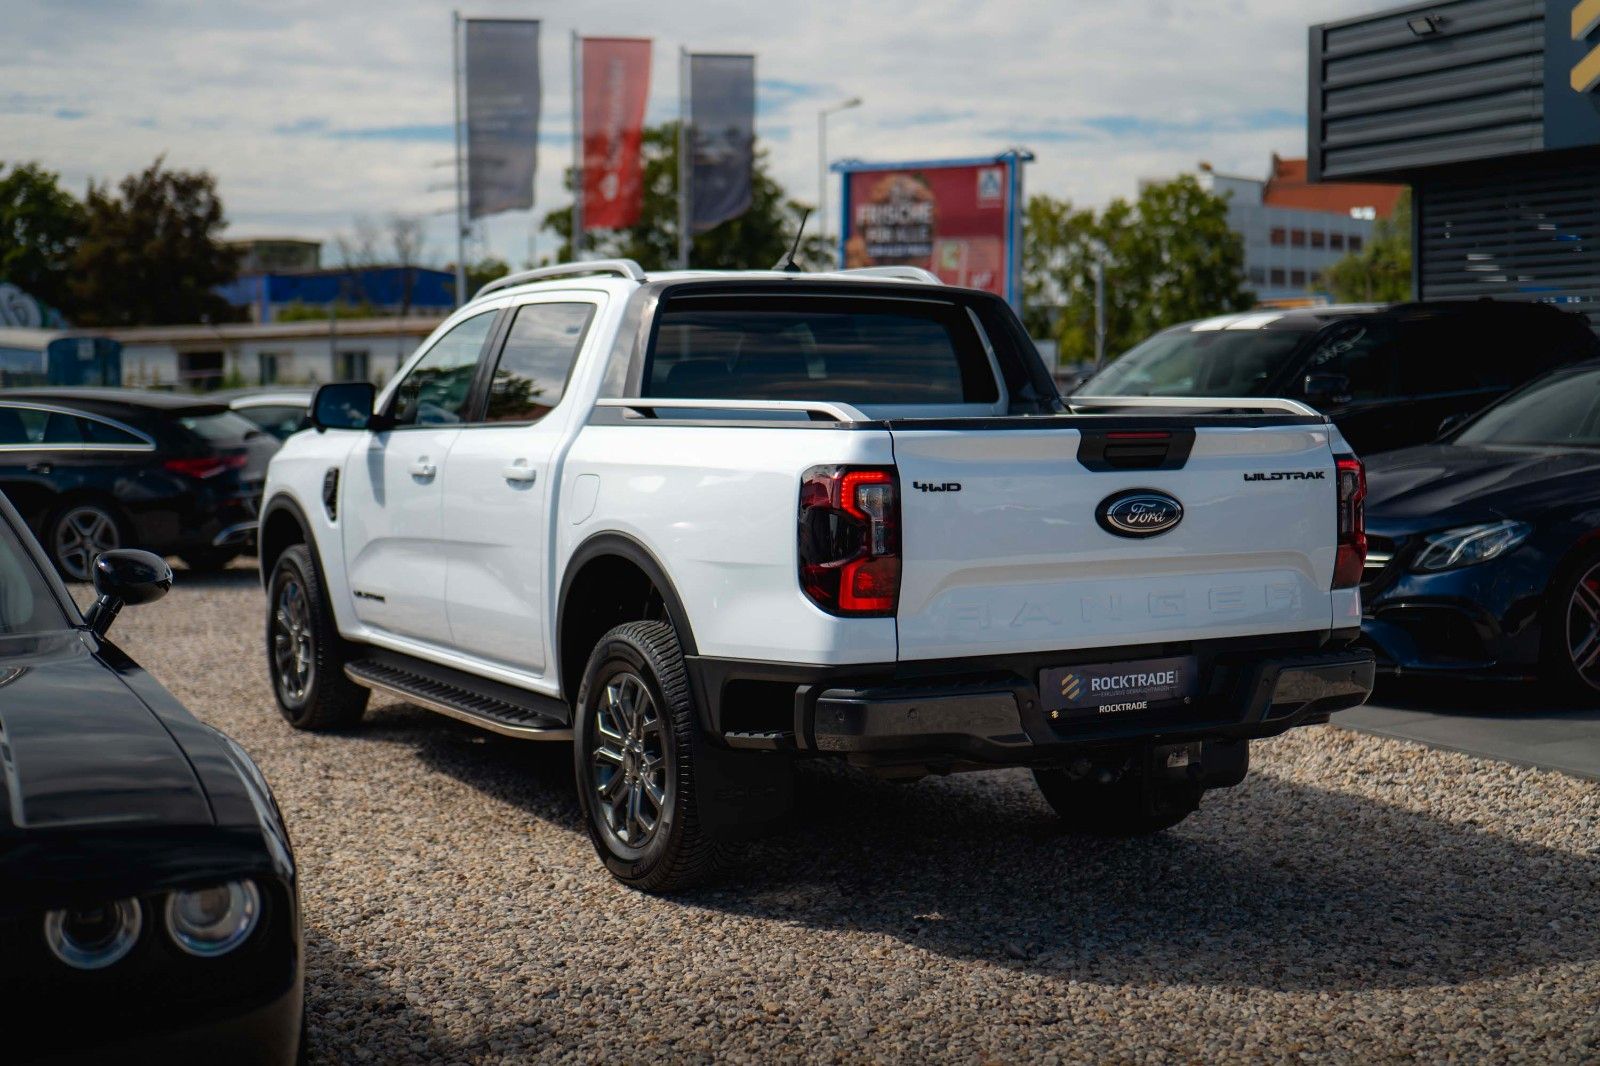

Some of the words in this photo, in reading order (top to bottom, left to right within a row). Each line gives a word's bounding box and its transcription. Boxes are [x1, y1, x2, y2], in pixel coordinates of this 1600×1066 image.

[1243, 471, 1325, 482] WILDTRAK
[912, 481, 962, 492] 4WD
[1127, 502, 1167, 524] Ford
[947, 582, 1302, 630] RANGER
[1091, 671, 1175, 691] ROCKTRADE
[1099, 701, 1148, 713] ROCKTRADE
